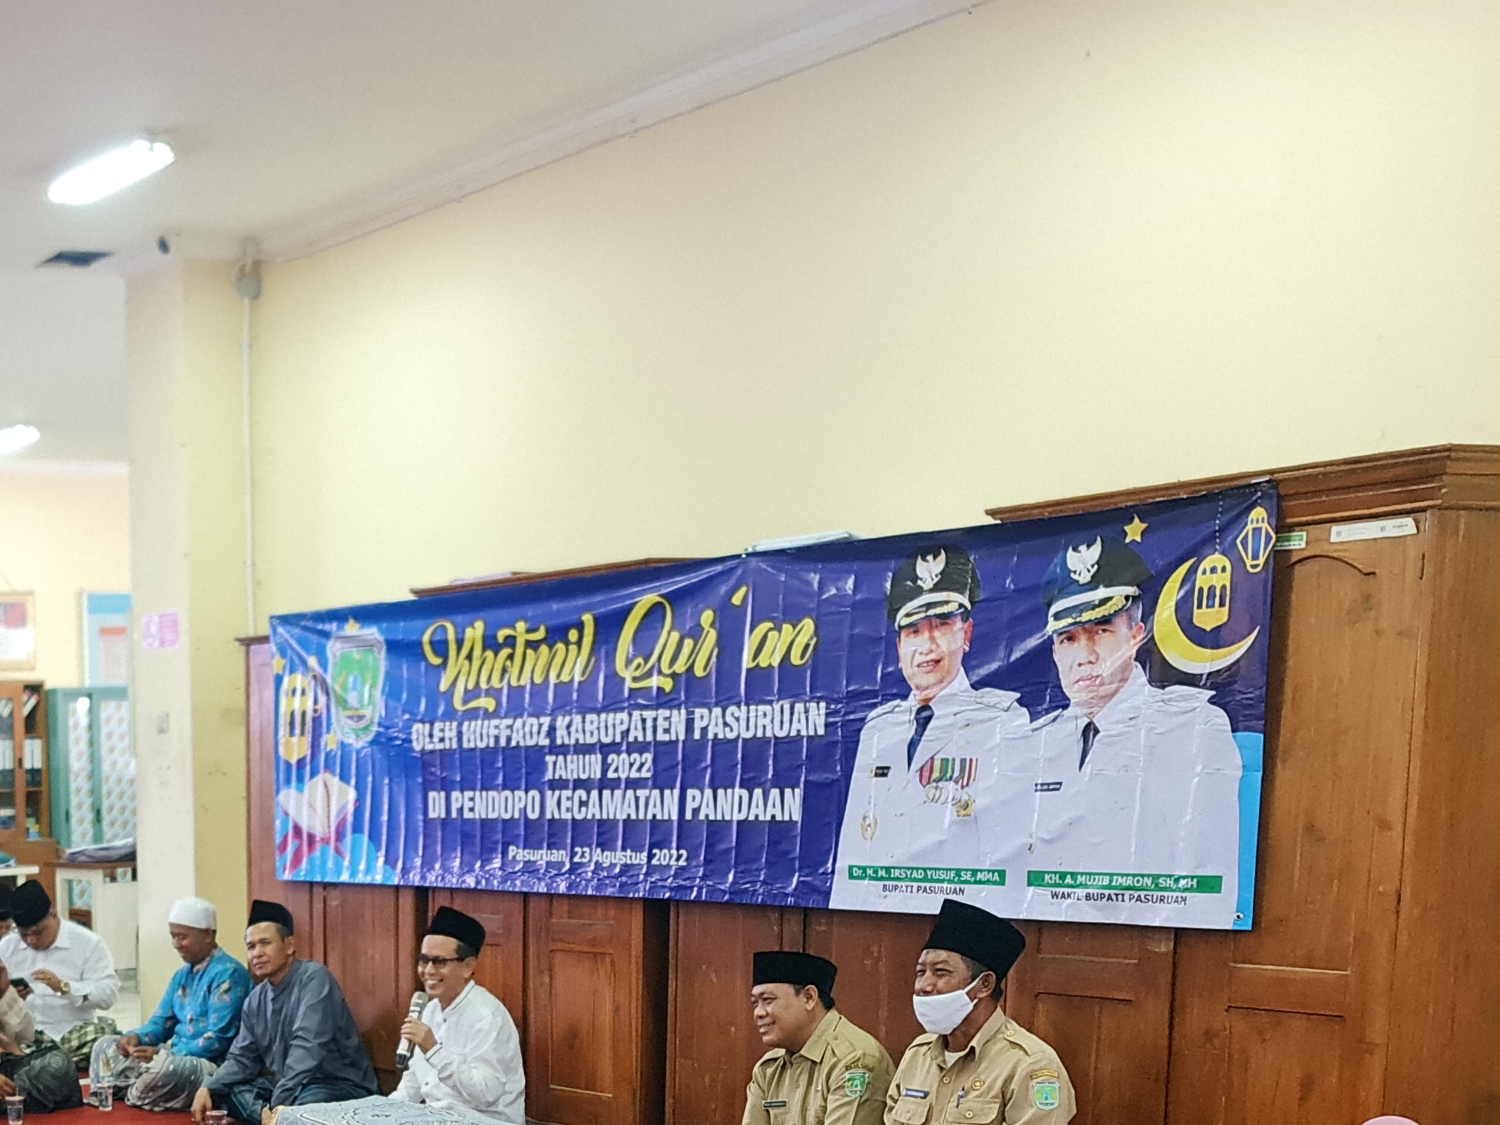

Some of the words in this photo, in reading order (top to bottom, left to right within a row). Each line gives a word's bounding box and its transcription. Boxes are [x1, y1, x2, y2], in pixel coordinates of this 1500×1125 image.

[411, 721, 458, 750] OLEH
[462, 716, 550, 749] HUFFADZ
[555, 708, 687, 746] KABUPATEN
[693, 701, 826, 741] PASURUAN
[545, 754, 603, 780] TAHUN
[607, 752, 653, 779] 2022
[428, 790, 446, 820] DI
[451, 789, 541, 820] PENDOPO
[546, 788, 677, 821] KECAMATAN
[685, 787, 801, 822] PANDAAN
[573, 846, 591, 863] 23
[594, 847, 648, 867] Agustus
[651, 848, 688, 866] 2022
[852, 867, 866, 877] Dr.
[866, 867, 876, 877] H.
[877, 868, 889, 878] M.
[890, 868, 925, 879] IRSYAD
[926, 869, 958, 882] YUSUF,
[960, 871, 975, 882] SE,
[976, 871, 1000, 882] MMA
[1044, 873, 1062, 884] KH.
[1064, 874, 1075, 884] A.
[1076, 874, 1110, 886] MUJIB
[1111, 875, 1155, 889] IMRON,
[1158, 876, 1177, 890] SH,
[882, 884, 914, 894] BUPATI
[916, 885, 965, 896] PASURUAN
[1085, 891, 1126, 903] BUPATI
[1128, 893, 1188, 906] PASURUAN
